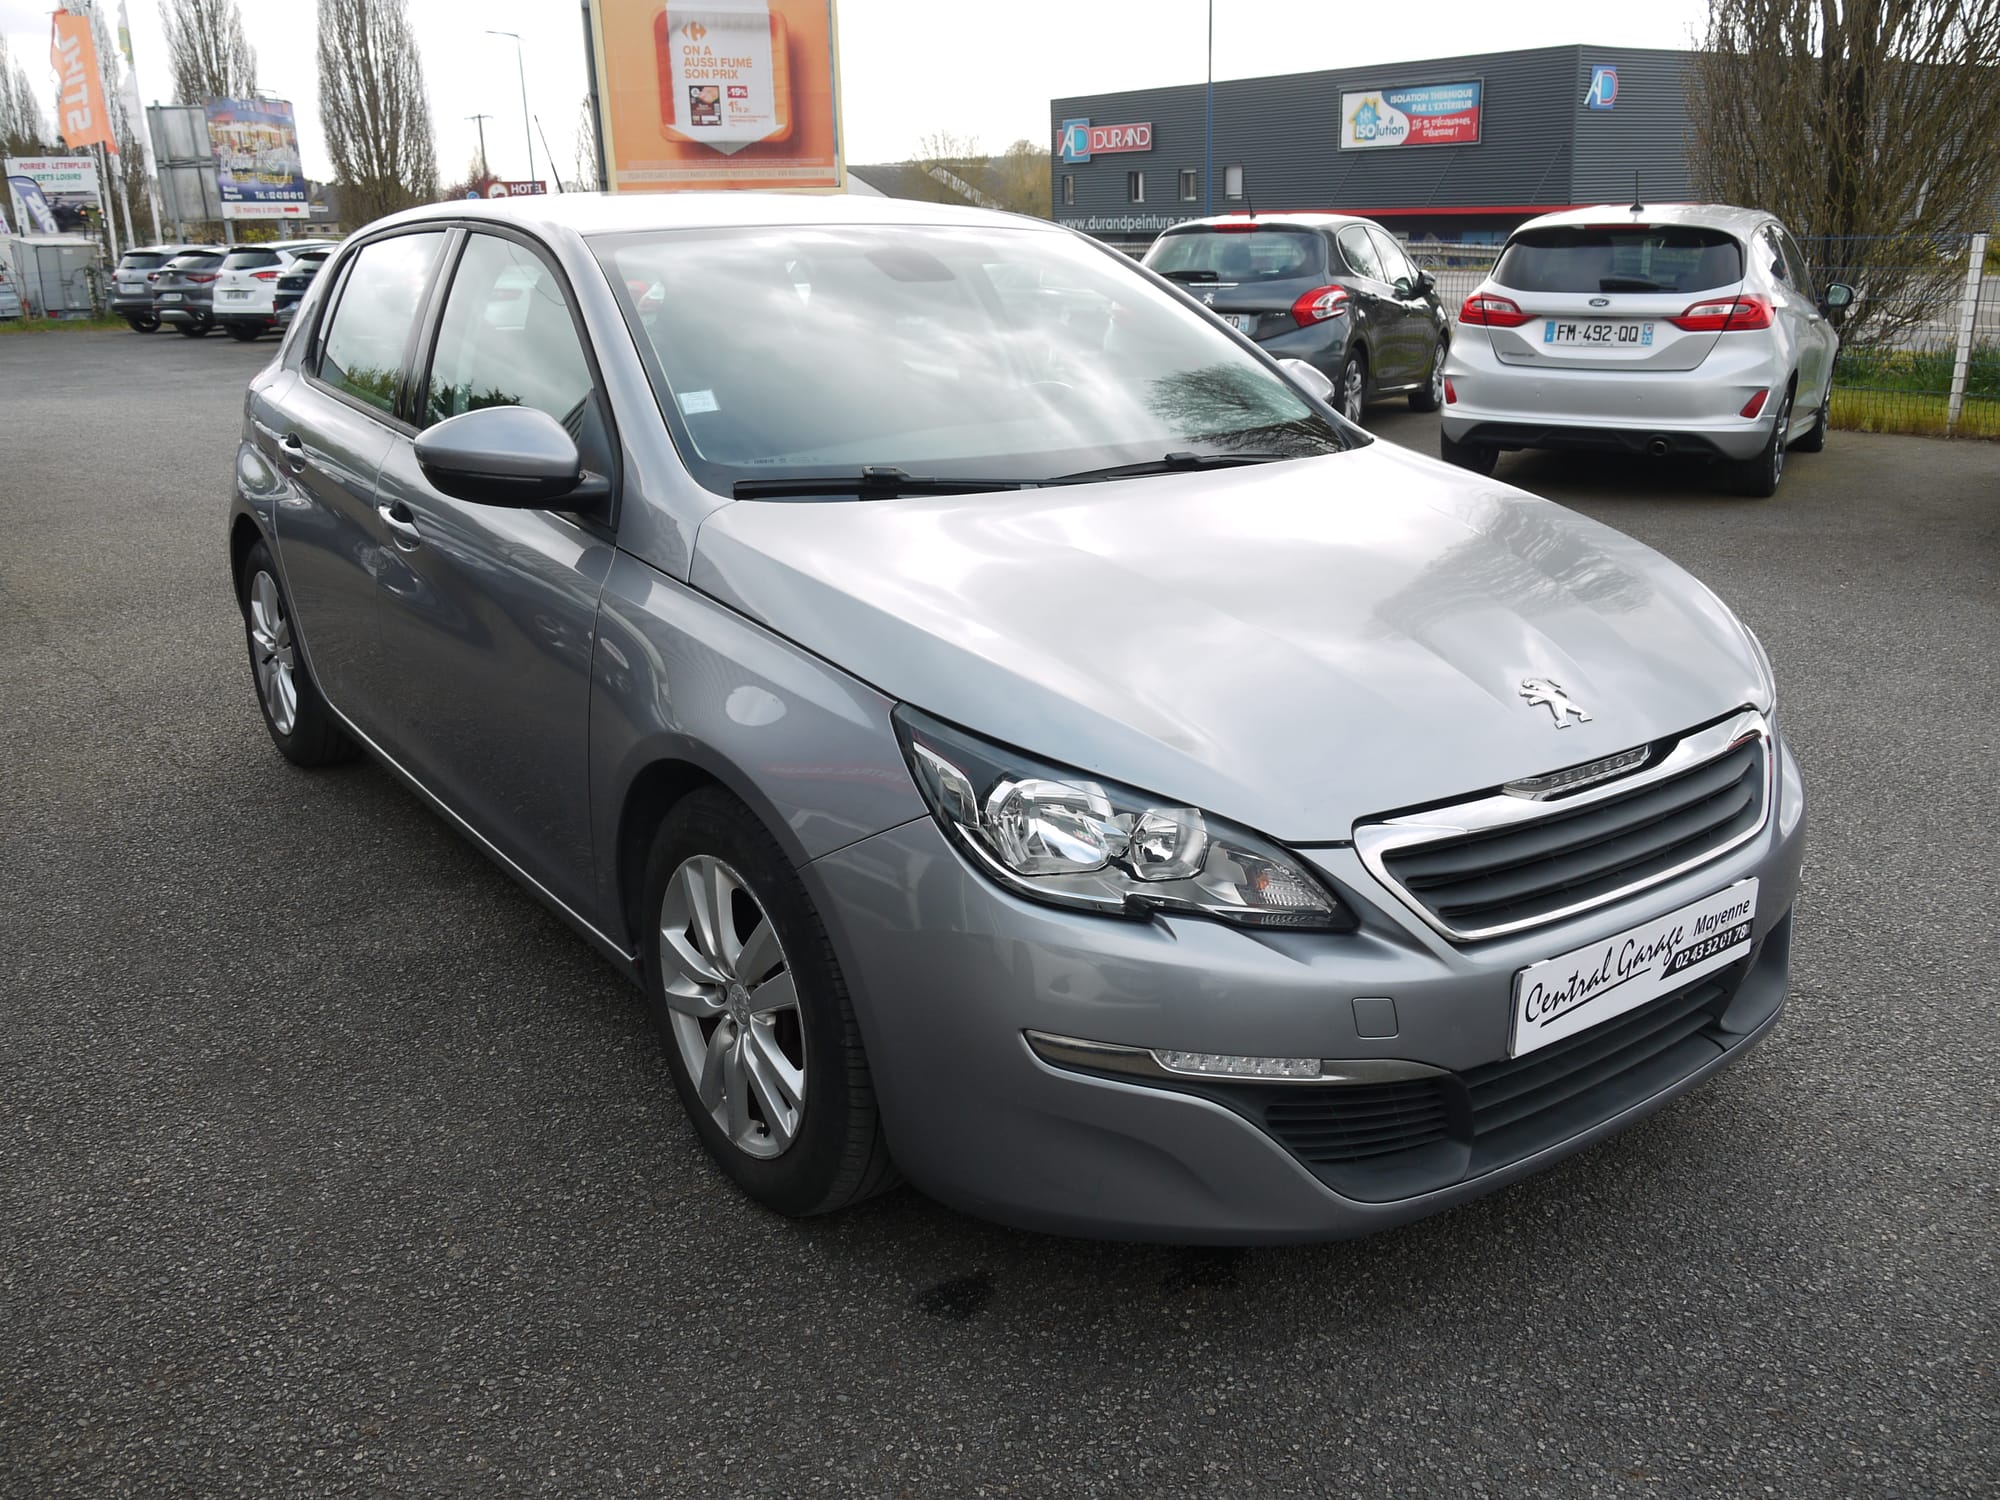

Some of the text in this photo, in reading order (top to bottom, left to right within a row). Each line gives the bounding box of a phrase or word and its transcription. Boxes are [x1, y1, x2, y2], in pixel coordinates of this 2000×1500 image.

[682, 45, 712, 56] ON A
[684, 55, 753, 69] AUSSI FUMÉ
[684, 68, 739, 80] SON PRIX
[1390, 88, 1473, 104] ISOLATION THERMIQUE
[1411, 103, 1427, 112] PAR
[1093, 126, 1151, 150] DURAND
[19, 162, 46, 170] POIRIER
[1556, 324, 1639, 343] FM-492-QQ
[1551, 752, 1637, 788] PEUGEOT
[1675, 950, 1690, 969] 02
[1690, 943, 1705, 961] 43
[1704, 937, 1720, 956] 32
[1719, 930, 1733, 949] 01
[1525, 899, 1751, 1023] Central Garage Mayenne
